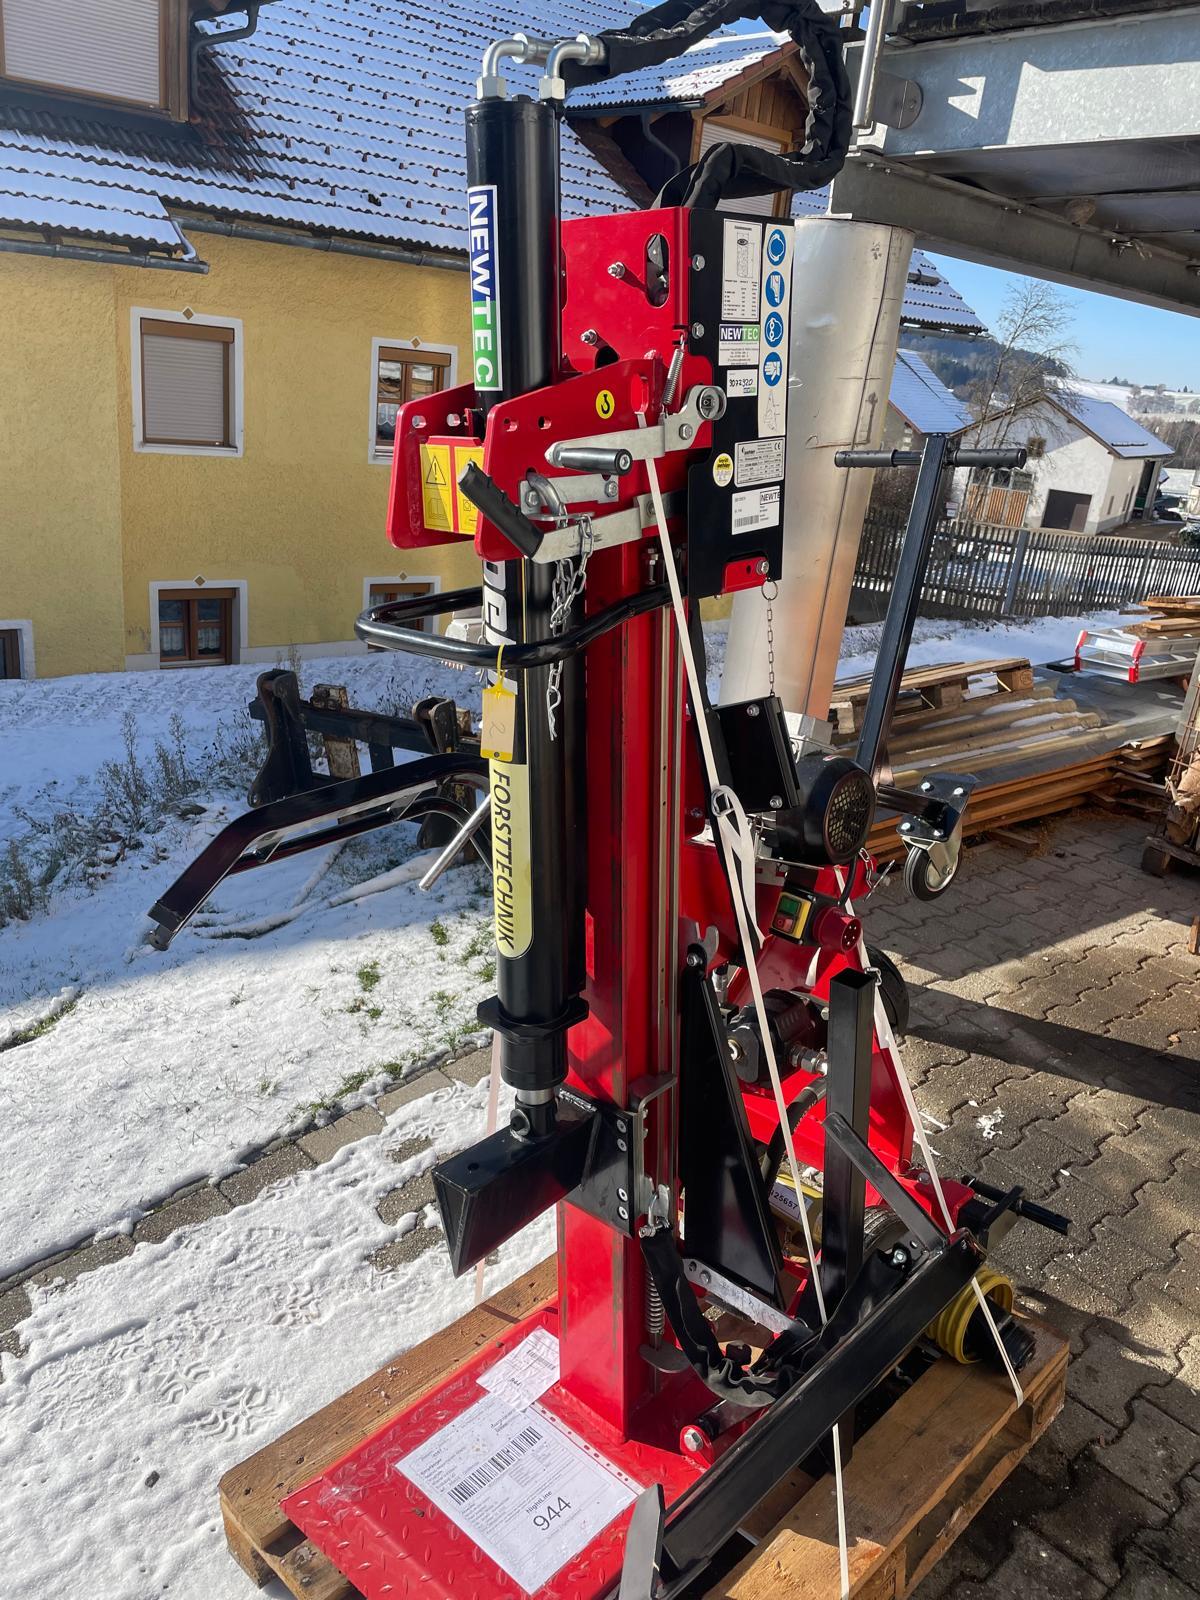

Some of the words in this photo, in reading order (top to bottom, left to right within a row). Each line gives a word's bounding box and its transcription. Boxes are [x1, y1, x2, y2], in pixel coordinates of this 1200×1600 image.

[469, 194, 494, 384] NEWTEC
[720, 328, 759, 340] NEWTEC
[493, 768, 515, 950] FORSTTECHNIK
[533, 1496, 571, 1531] 944
